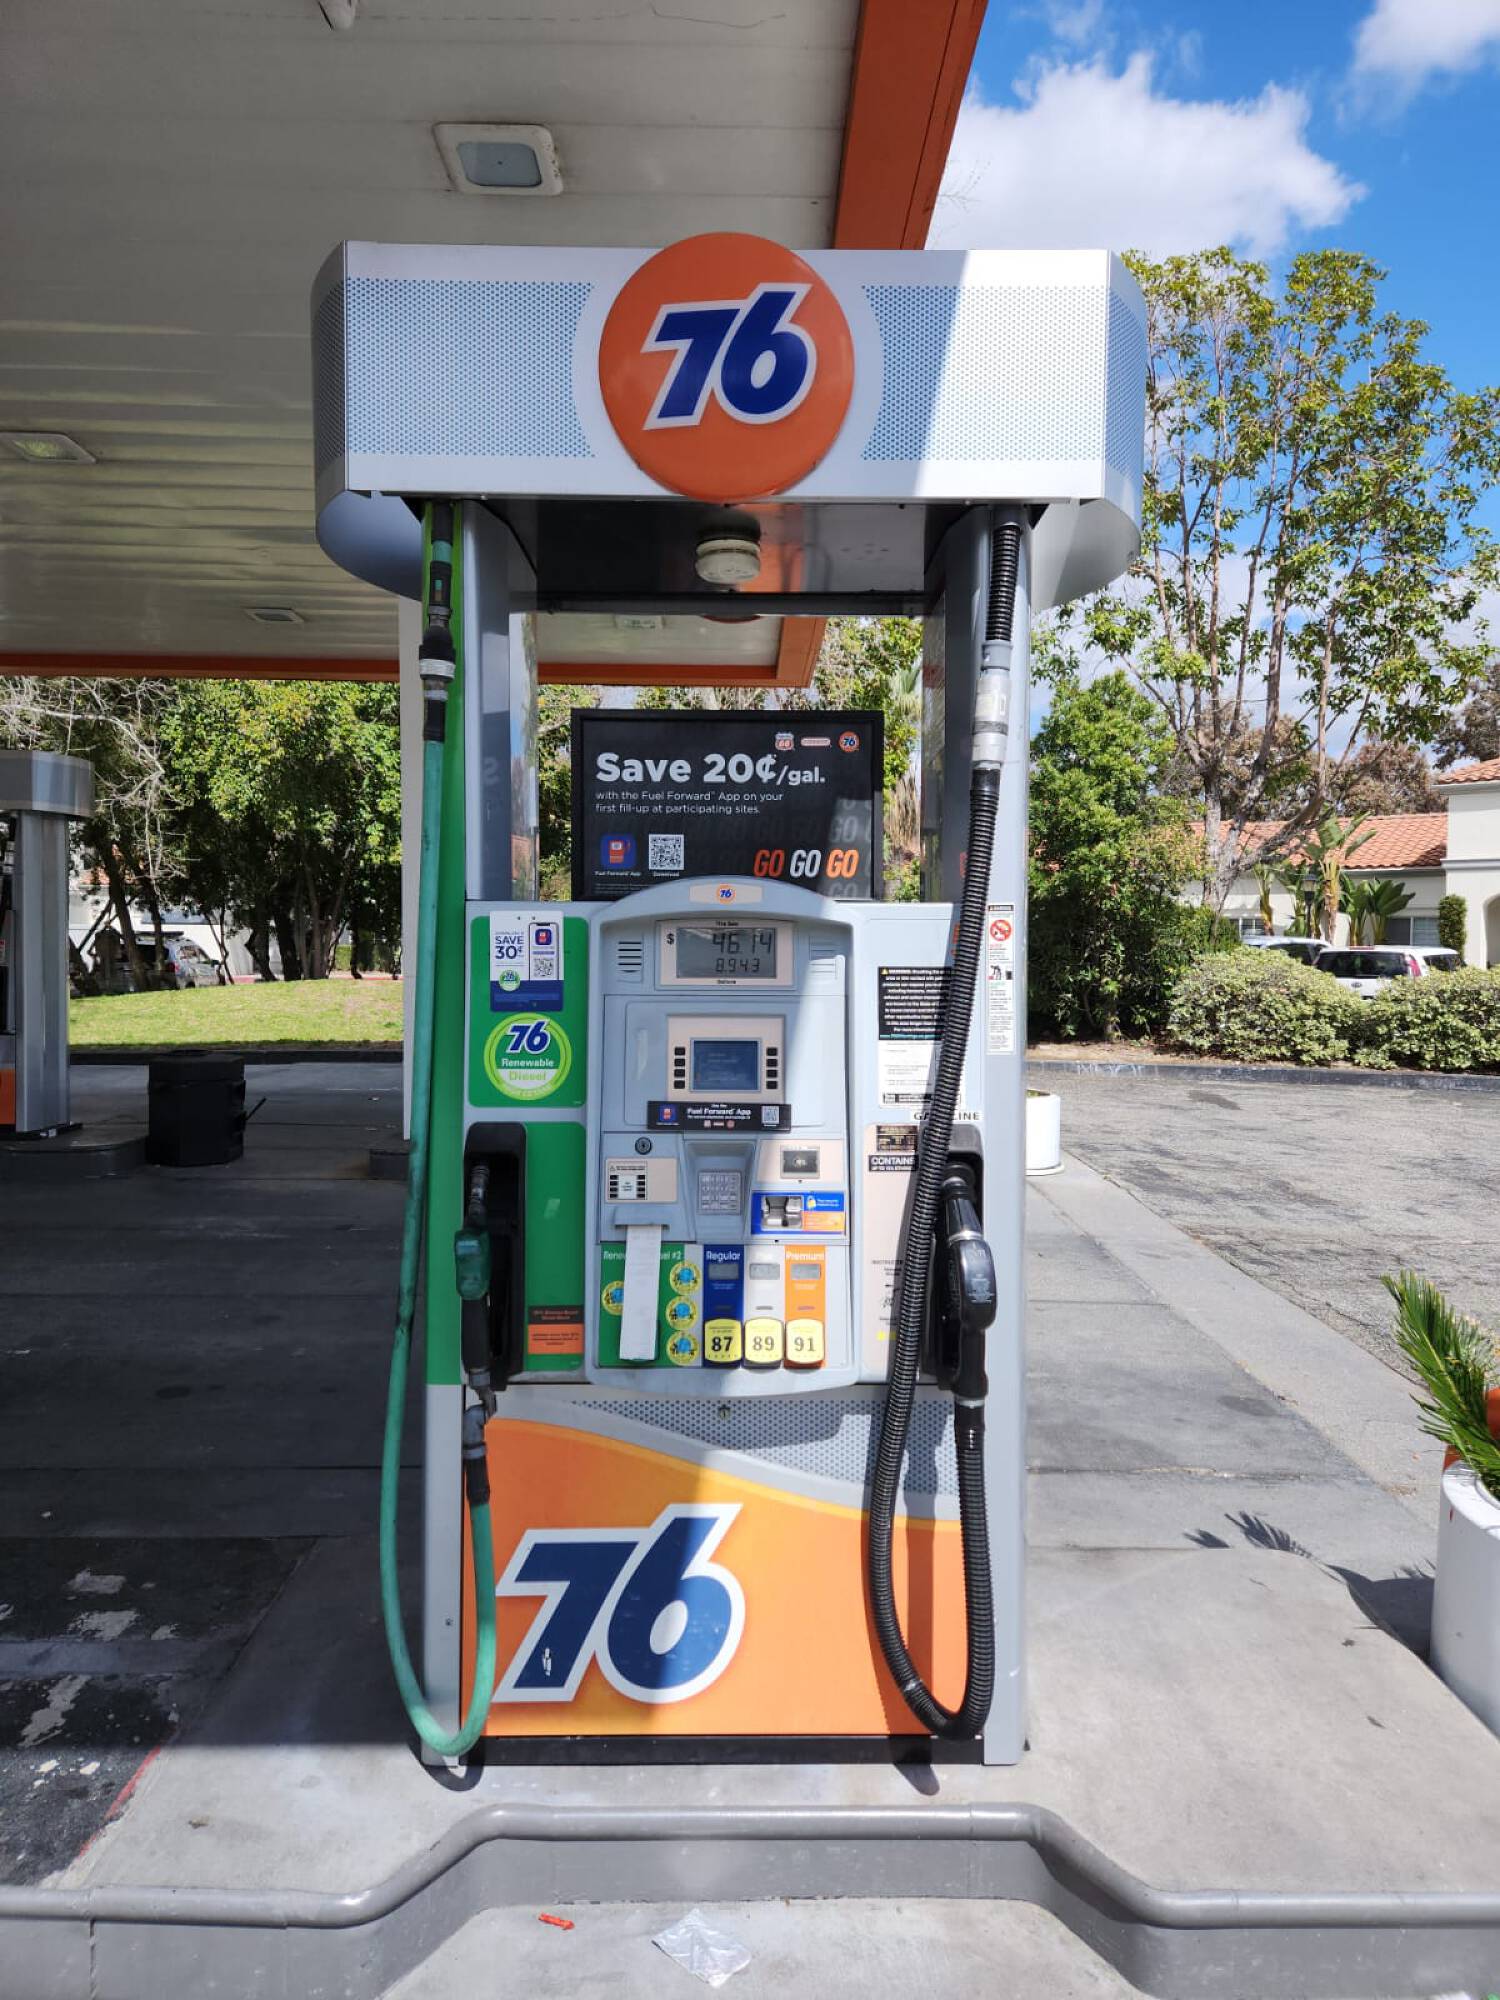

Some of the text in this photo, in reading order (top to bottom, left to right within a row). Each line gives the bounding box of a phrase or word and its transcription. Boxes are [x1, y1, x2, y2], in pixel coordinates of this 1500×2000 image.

[640, 282, 817, 430] 76
[595, 752, 692, 783] Save
[596, 791, 619, 800] with
[622, 791, 639, 800] the
[641, 791, 664, 800] Fuel
[718, 792, 740, 802] App
[744, 793, 757, 801] on
[760, 793, 783, 802] your
[596, 804, 616, 813] first
[620, 804, 650, 814] fill-up
[652, 804, 662, 813] at
[666, 804, 732, 815] participating
[753, 849, 859, 878] GO GO GO
[495, 935, 524, 945] SAVE
[666, 933, 675, 945] $
[507, 1021, 550, 1054] 76
[501, 1058, 554, 1067] Renewable
[913, 1111, 981, 1121] GAINE
[706, 1251, 741, 1262] Regular
[785, 1251, 824, 1260] Premium
[711, 1336, 733, 1351] 87
[752, 1336, 775, 1351] 89
[794, 1337, 816, 1352] 91
[490, 1503, 745, 1704] 76
